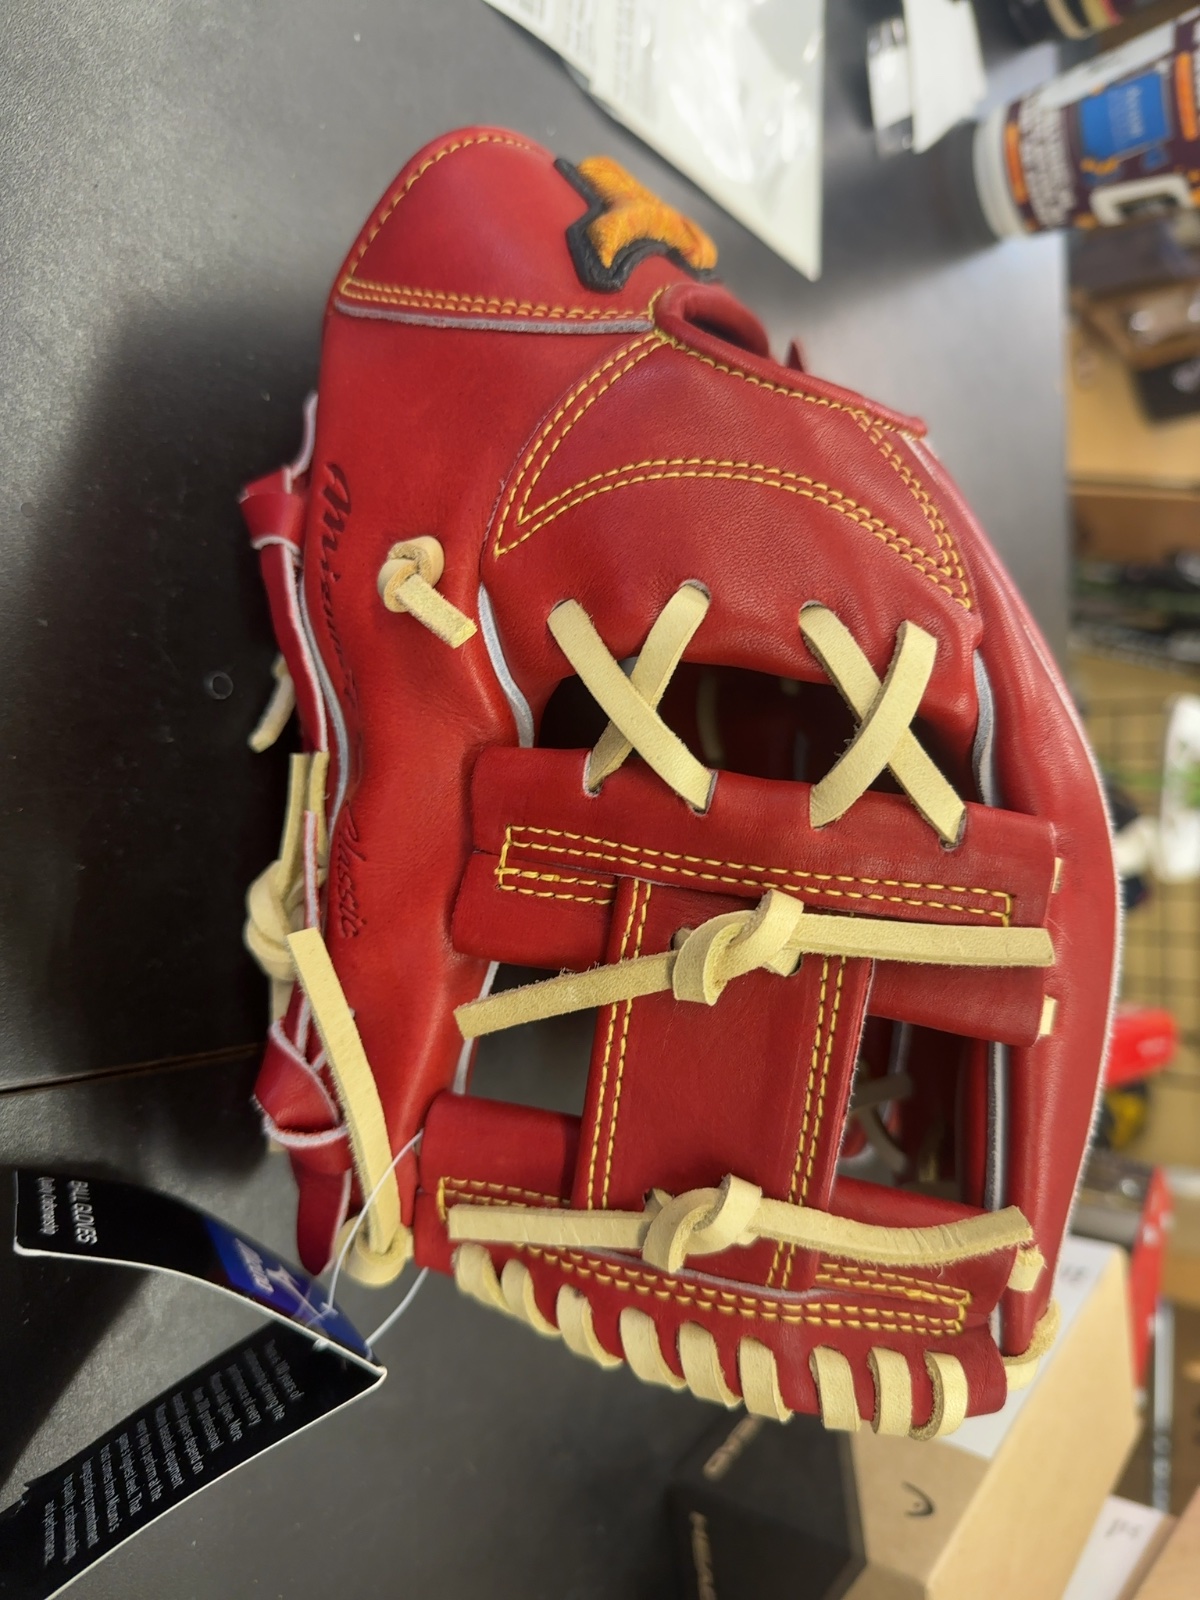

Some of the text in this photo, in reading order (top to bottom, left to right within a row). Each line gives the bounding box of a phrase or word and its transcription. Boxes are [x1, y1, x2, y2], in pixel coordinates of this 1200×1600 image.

[70, 1180, 98, 1245] BALL GLOVES
[261, 1381, 286, 1421] driving the
[196, 1409, 224, 1451] professional
[228, 1417, 243, 1442] More
[141, 1442, 152, 1455] to
[184, 1434, 204, 1464] depend
[140, 1450, 157, 1481] perform
[164, 1448, 185, 1489] equipment
[192, 1460, 204, 1475] on
[100, 1442, 121, 1533] trust comes from Mizuno's
[122, 1450, 136, 1481] highest
[129, 1492, 142, 1516] That
[148, 1476, 161, 1489] at
[150, 1483, 162, 1502] the
[44, 1499, 57, 1517] and
[83, 1498, 100, 1549] commitment
